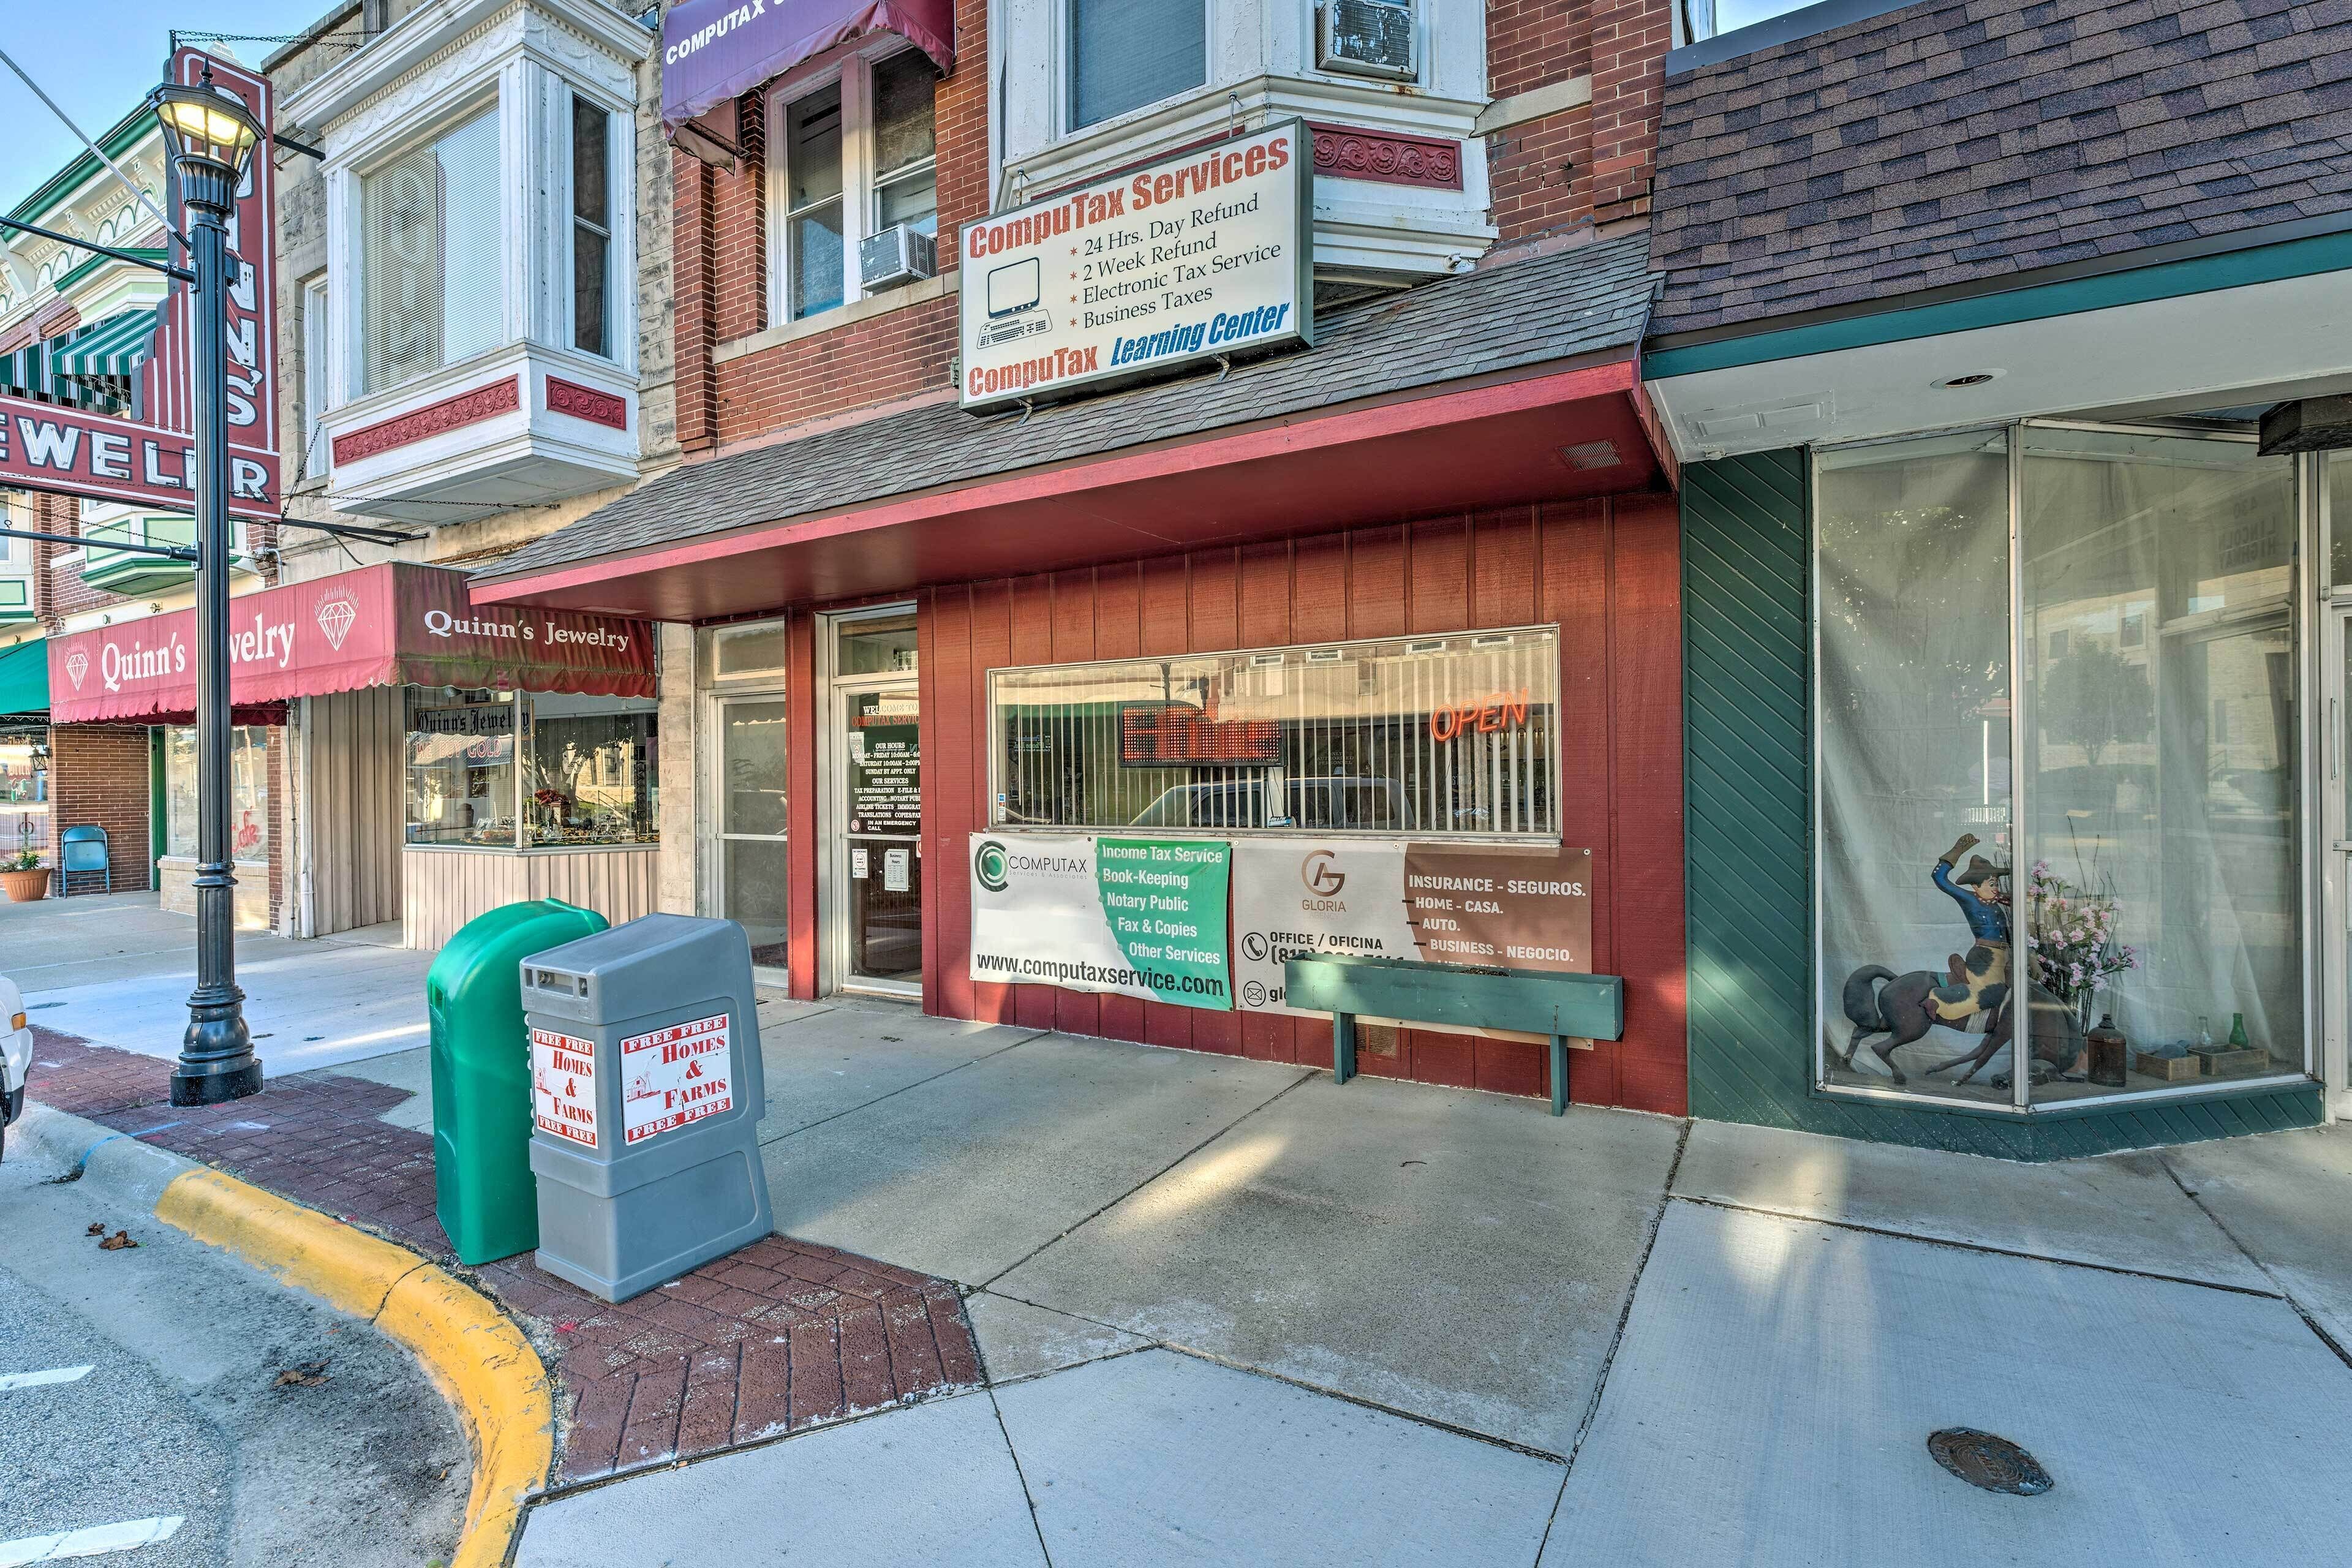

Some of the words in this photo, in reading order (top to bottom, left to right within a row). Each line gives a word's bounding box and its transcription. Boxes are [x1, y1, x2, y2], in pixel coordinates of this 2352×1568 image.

[666, 0, 766, 65] COMPUTAX
[970, 187, 1125, 258] CompuTax
[1132, 138, 1289, 211] Services
[1084, 239, 1103, 256] 24
[1108, 232, 1144, 252] Hrs.
[1150, 221, 1183, 239] Day
[1191, 192, 1259, 228] Refund
[1083, 265, 1093, 282] 2
[1098, 251, 1146, 279] Week
[1151, 231, 1217, 263] Refund
[1083, 274, 1169, 305] Electronic
[1174, 265, 1207, 284] Tax
[1212, 245, 1281, 271] Service
[1084, 302, 1156, 330] Business
[1161, 285, 1213, 311] Taxes
[969, 344, 1098, 397] CompuTax
[1110, 323, 1205, 366] Learning
[1208, 302, 1291, 345] Center
[424, 610, 535, 640] Quinn's
[544, 622, 629, 652] Jewelry
[102, 631, 186, 692] Quinn's
[418, 711, 466, 733] Quinn's
[470, 707, 529, 734] Jewely
[852, 715, 891, 726] COMPUTAX
[863, 704, 904, 715] WELCOME
[1431, 687, 1528, 742] OPEN
[416, 741, 434, 759] WE
[440, 741, 461, 758] BUY
[467, 739, 502, 758] GOLD
[1009, 856, 1087, 873] COMPUTAX
[1102, 845, 1147, 860] Income
[1150, 846, 1171, 861] Tax
[1175, 847, 1223, 864] Service
[1102, 868, 1189, 890] Book-Keeping
[1409, 875, 1493, 892] INSURANCE
[1507, 880, 1587, 897] SEGUROS.
[1107, 892, 1146, 913] Notary
[1150, 894, 1189, 912] Public
[1302, 899, 1346, 913] GLORIA
[1415, 897, 1453, 911] HOME
[1464, 900, 1504, 914] CASA.
[1118, 917, 1139, 933] Fax
[1142, 919, 1152, 933] &
[1155, 919, 1198, 938] Copies
[1422, 918, 1461, 932] AUTO.
[1270, 932, 1314, 945] OFFICE
[1329, 935, 1384, 950] OFICINA
[1430, 939, 1494, 956] BUSINESS
[1507, 946, 1574, 962] NEGOCIO.
[1129, 942, 1162, 959] Other
[1166, 943, 1220, 965] Services
[977, 953, 1224, 997] www.computaxservice.com
[535, 1032, 562, 1046] FREE
[565, 1039, 590, 1054] FREE
[628, 1030, 673, 1052] FREE
[680, 1017, 723, 1039] FREE
[686, 1060, 704, 1080] &
[565, 1077, 577, 1098] &
[538, 1115, 562, 1133] FREE
[566, 1126, 594, 1144] FREE
[632, 1117, 677, 1140] FREE
[684, 1100, 727, 1122] FREE
